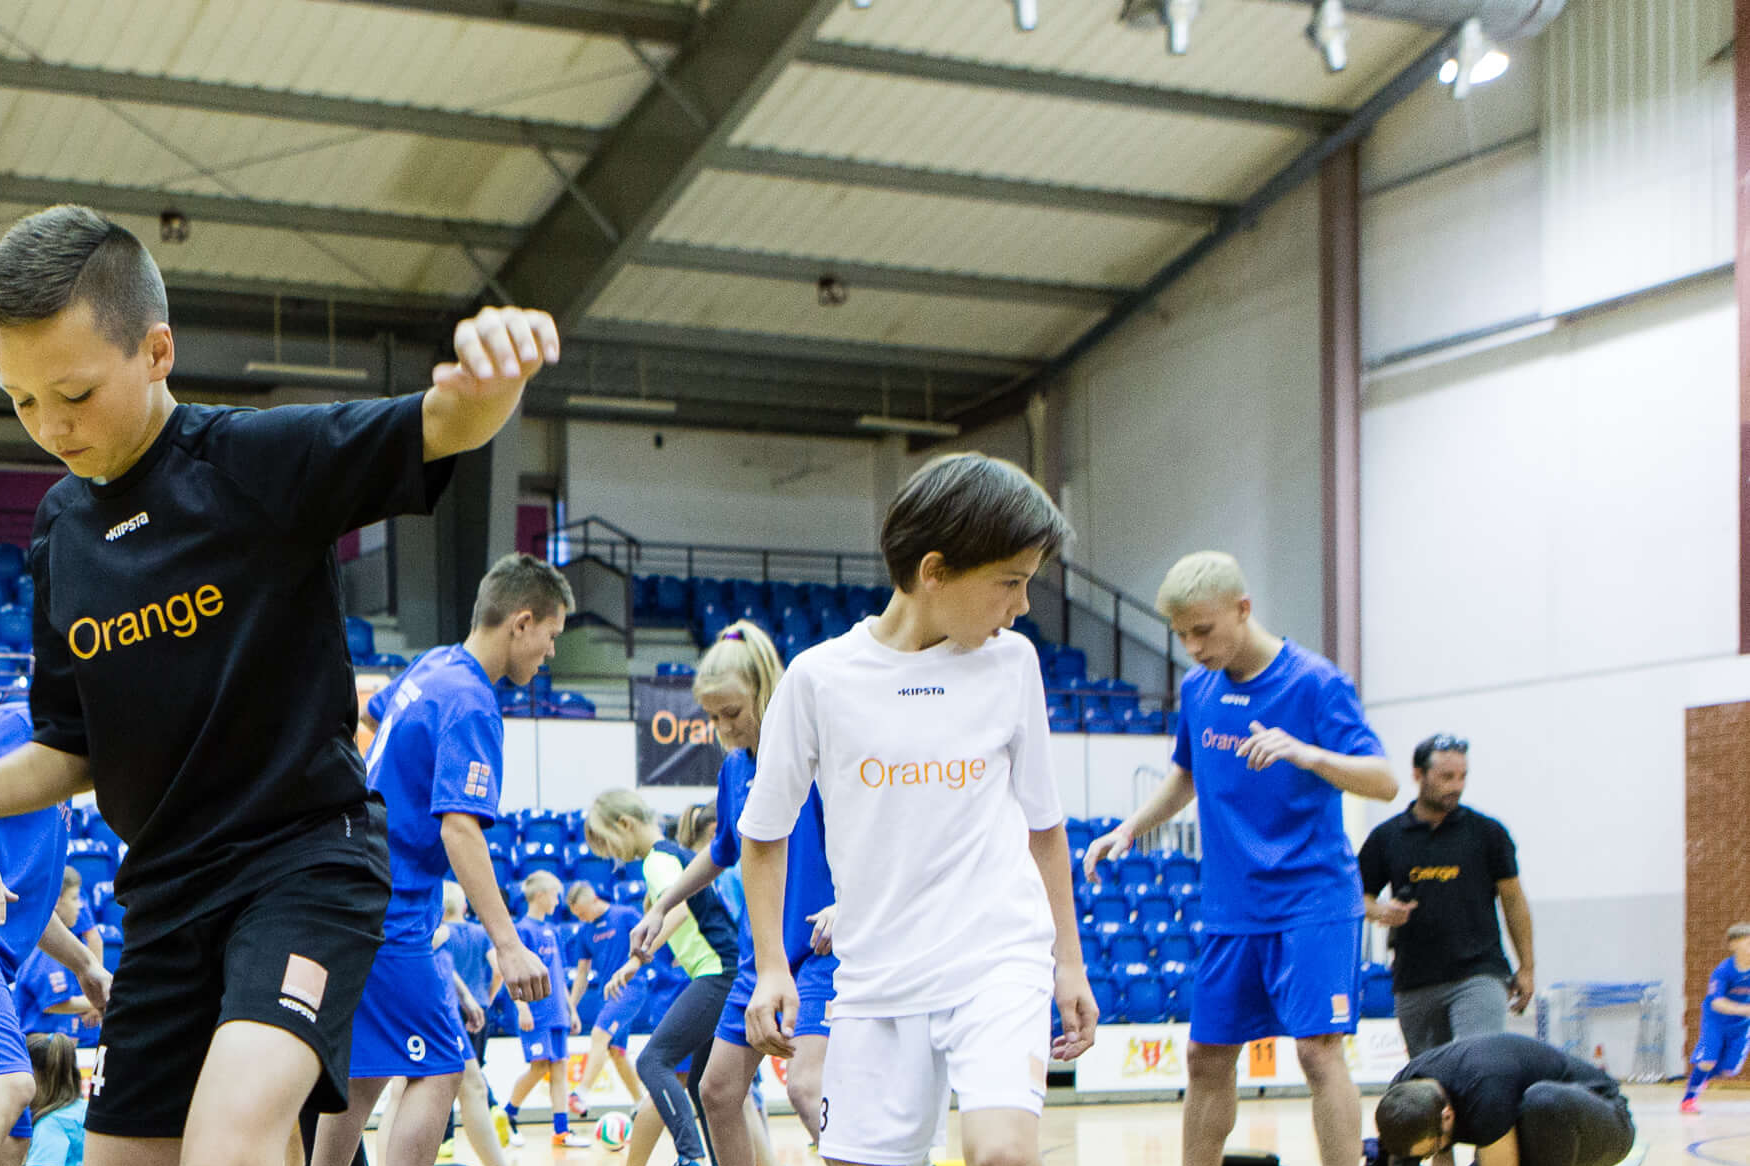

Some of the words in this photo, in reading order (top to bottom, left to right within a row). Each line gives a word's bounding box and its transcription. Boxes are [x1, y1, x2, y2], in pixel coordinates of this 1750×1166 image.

[68, 584, 225, 660] Orange
[858, 757, 986, 791] Orange
[406, 1034, 427, 1061] 9
